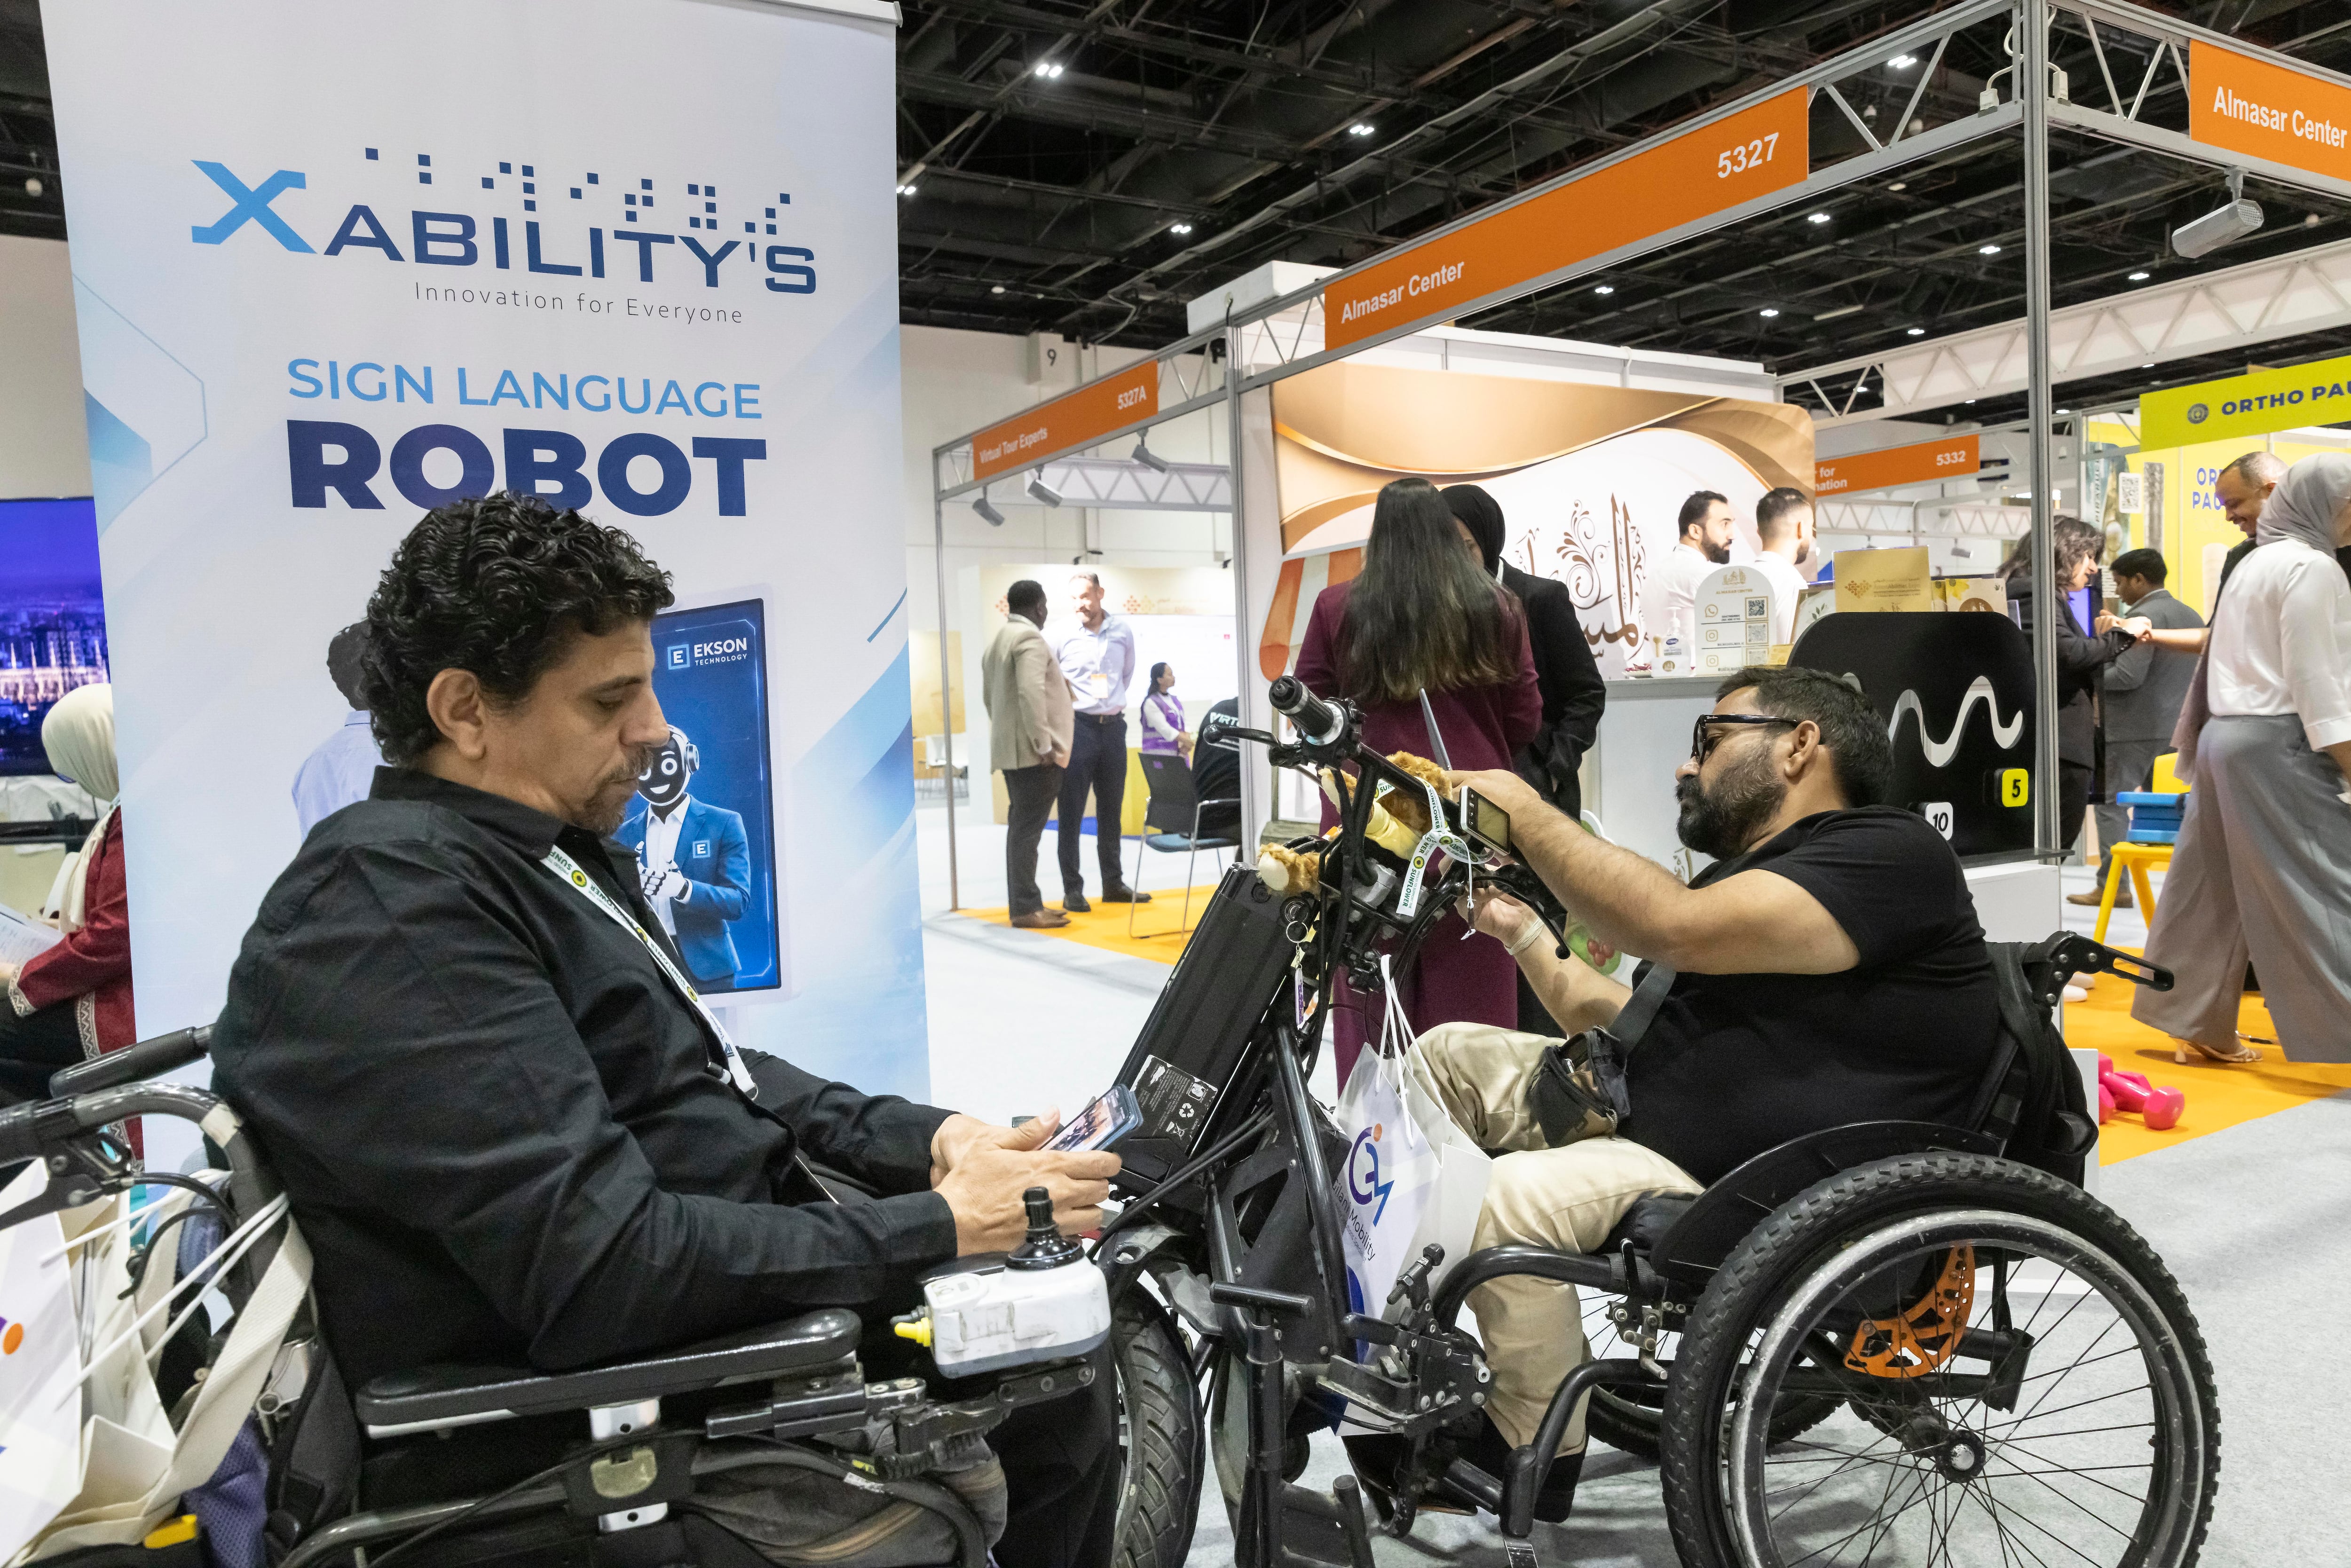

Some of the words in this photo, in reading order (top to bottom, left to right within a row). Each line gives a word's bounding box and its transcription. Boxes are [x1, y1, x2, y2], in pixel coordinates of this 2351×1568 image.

[2213, 86, 2288, 132] Almasar
[2292, 109, 2347, 149] Center
[1717, 132, 1779, 179] 5327
[416, 282, 563, 310] Innovation
[577, 292, 614, 314] for
[627, 298, 742, 324] Everyone
[1341, 285, 1404, 324] Almasar
[1408, 261, 1465, 297] Center
[1046, 349, 1057, 366] 9
[287, 358, 434, 404] SIGN
[458, 367, 763, 419] LANGUAGE
[1117, 385, 1147, 410] 5327A
[2221, 390, 2304, 416] ORTHO
[979, 441, 1002, 464] Virtual
[1002, 440, 1018, 455] Tour
[1019, 427, 1048, 449] Experts
[1936, 450, 1966, 466] 5332
[287, 420, 767, 517] ROBOT
[1819, 466, 1836, 478] for
[1815, 478, 1848, 492] nation
[673, 650, 684, 664] E
[694, 638, 748, 658] EKSON
[694, 653, 748, 666] TECHNOLOGY
[2012, 779, 2021, 797] 5
[1428, 788, 1440, 829] SUNFLOWER
[1933, 813, 1949, 832] 10
[697, 844, 707, 855] E
[1402, 868, 1417, 907] SUNFLOWER
[650, 943, 686, 986] SUNFLOWER
[1349, 1209, 1375, 1261] Mobility
